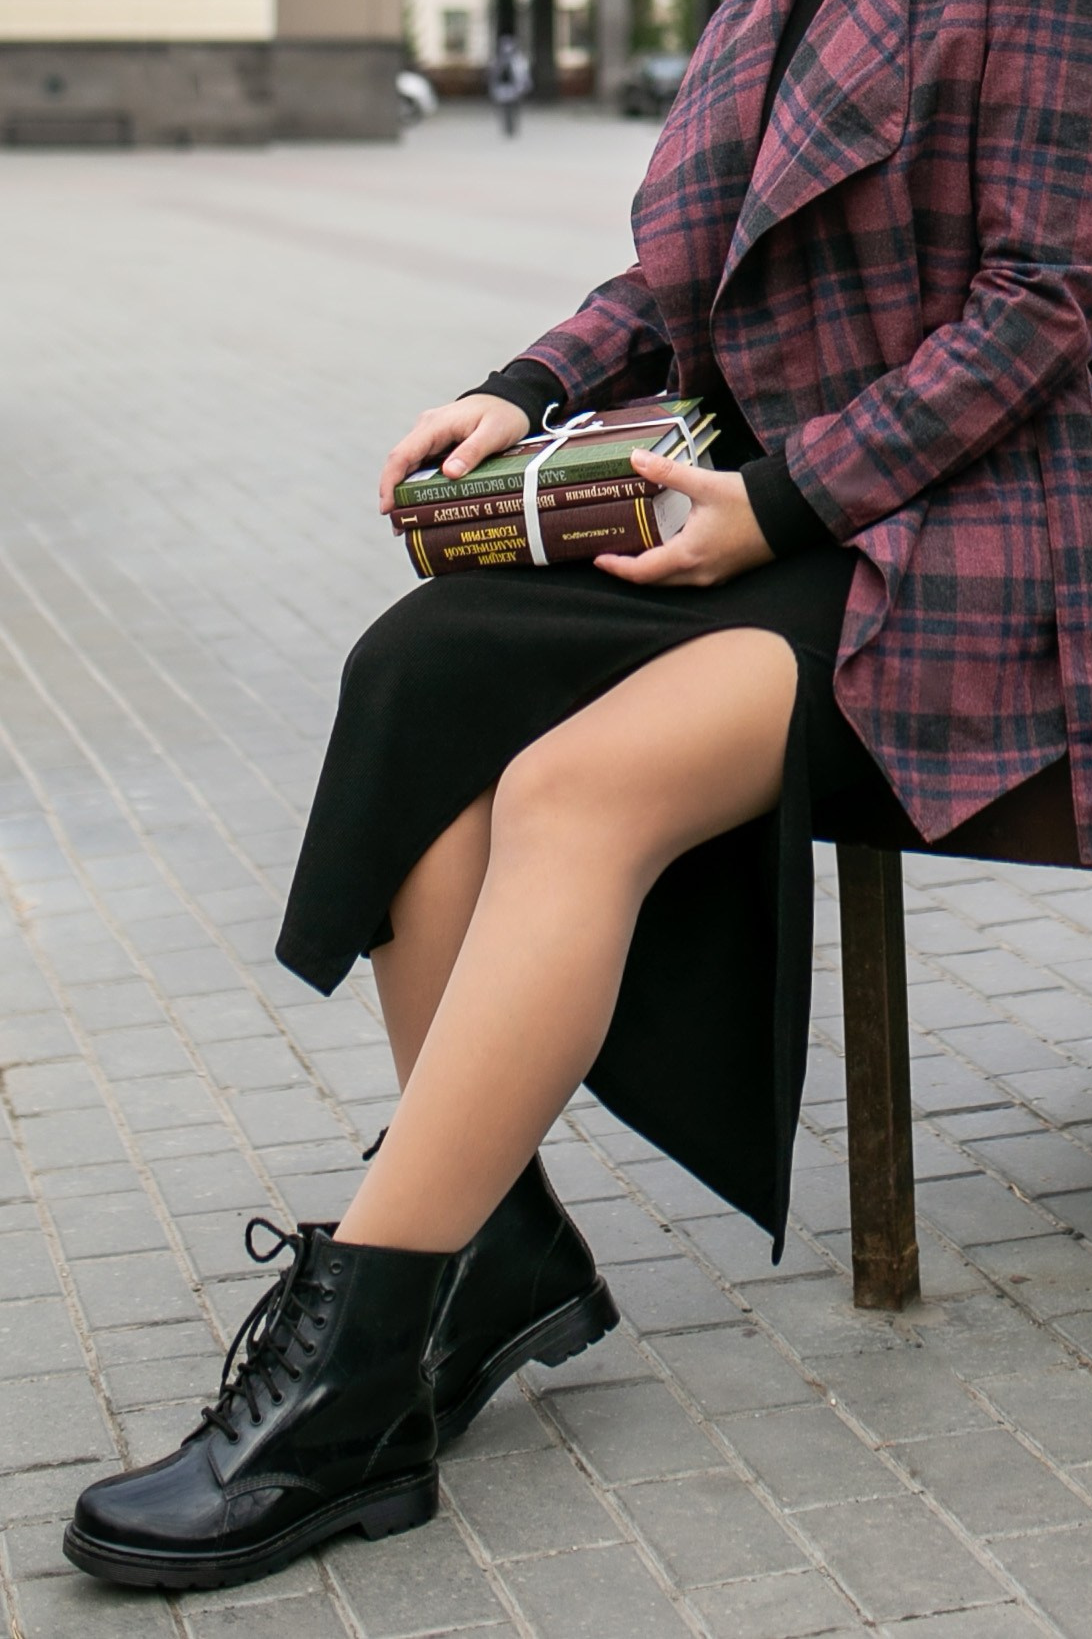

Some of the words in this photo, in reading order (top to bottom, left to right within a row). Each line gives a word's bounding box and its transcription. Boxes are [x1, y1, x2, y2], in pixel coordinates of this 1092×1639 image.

[507, 477, 523, 488] ПО
[539, 470, 567, 484] ЗАДА
[414, 485, 457, 502] АЛГЕБРЕ
[460, 478, 506, 497] ВЫСШЕЙ
[565, 485, 621, 501] Кострикин
[621, 485, 634, 496] И.
[634, 482, 646, 494] А.
[433, 504, 480, 522] АЛГЕБРУ
[484, 503, 493, 515] В
[460, 525, 518, 543] ГЕОМЕТРИИ
[562, 529, 610, 541] АЛЕКСАНДРОВ
[443, 537, 527, 561] АНАЛИТИЧЕСКОЙ
[478, 551, 517, 565] ЛЕКЦИИ
